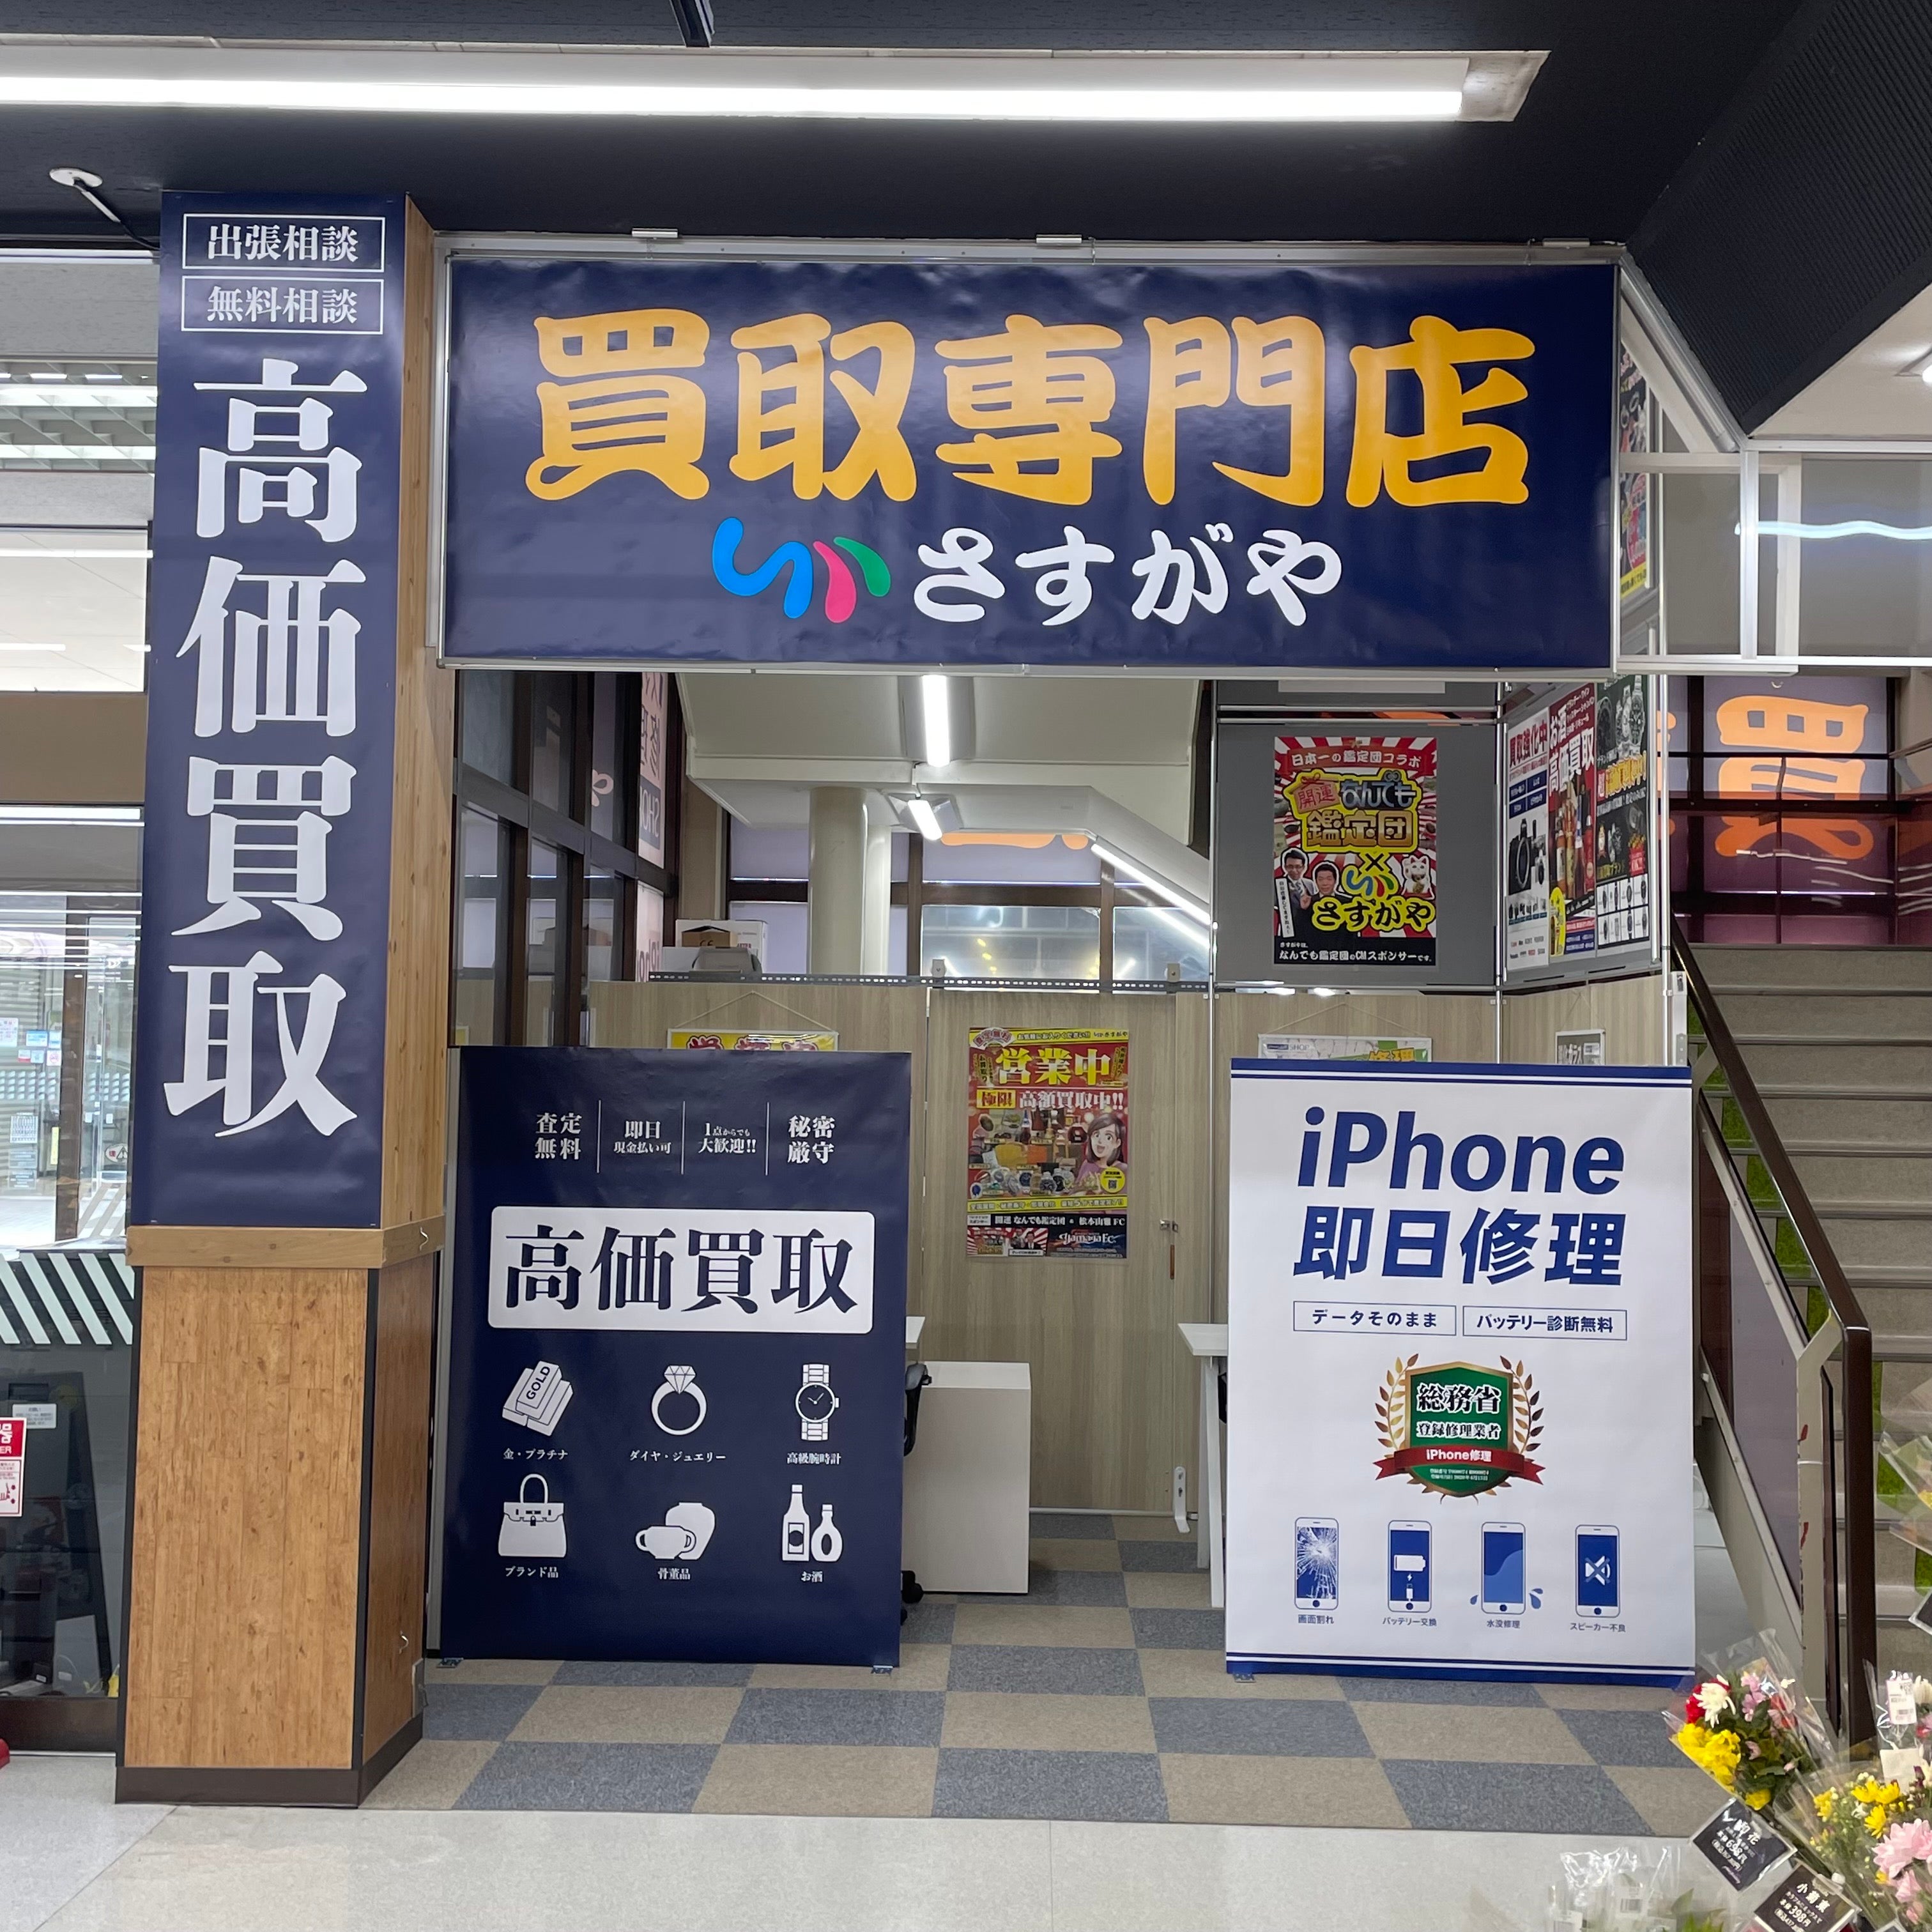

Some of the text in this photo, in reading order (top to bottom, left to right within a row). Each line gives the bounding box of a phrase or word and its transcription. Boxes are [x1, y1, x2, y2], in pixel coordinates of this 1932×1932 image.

[208, 224, 358, 263] 出張相談
[207, 286, 358, 324] 無料相談
[526, 309, 1535, 509] 買取専門店
[914, 523, 1342, 626] さすがや
[164, 358, 367, 1138] 高価買取
[1292, 750, 1422, 768] 日本一の鑑定団コラボ
[1299, 783, 1335, 810] 開運
[1307, 809, 1414, 847] 鑑定団
[1317, 901, 1431, 928] さすがや
[995, 1047, 1111, 1086] 営業中
[536, 1113, 582, 1134] 査定
[625, 1121, 661, 1139] 即日
[705, 1123, 750, 1137] 1点からでも
[788, 1115, 835, 1138] 秘密
[535, 1138, 581, 1160] 無料
[613, 1142, 671, 1154] 現金払い可
[698, 1138, 756, 1154] 大歓迎!!
[788, 1140, 834, 1163] 厳守
[1298, 1106, 1624, 1195] iPhone
[1293, 1206, 1626, 1285] 即日修理
[505, 1224, 858, 1314] 高価買取
[1312, 1309, 1437, 1328] データそのまま
[1476, 1314, 1613, 1333] バッテリー診断無料
[525, 1366, 551, 1400] GOLD
[1416, 1383, 1502, 1414] 総務省
[1416, 1421, 1502, 1440] 登録修理業者
[503, 1448, 569, 1460] 金・プラチナ
[630, 1450, 726, 1462] ダイヤ・ジュエリー
[786, 1452, 841, 1465] 高級腕時計
[1426, 1448, 1492, 1462] iPhone修理
[505, 1566, 559, 1579] ブランド品
[657, 1568, 691, 1580] 骨董品
[801, 1570, 823, 1583] お酒
[1298, 1614, 1335, 1625] 画面割れ
[1382, 1617, 1437, 1627] バッテリー交換
[1487, 1619, 1521, 1629] 水没修理
[1570, 1623, 1626, 1632] スピーカー不良
